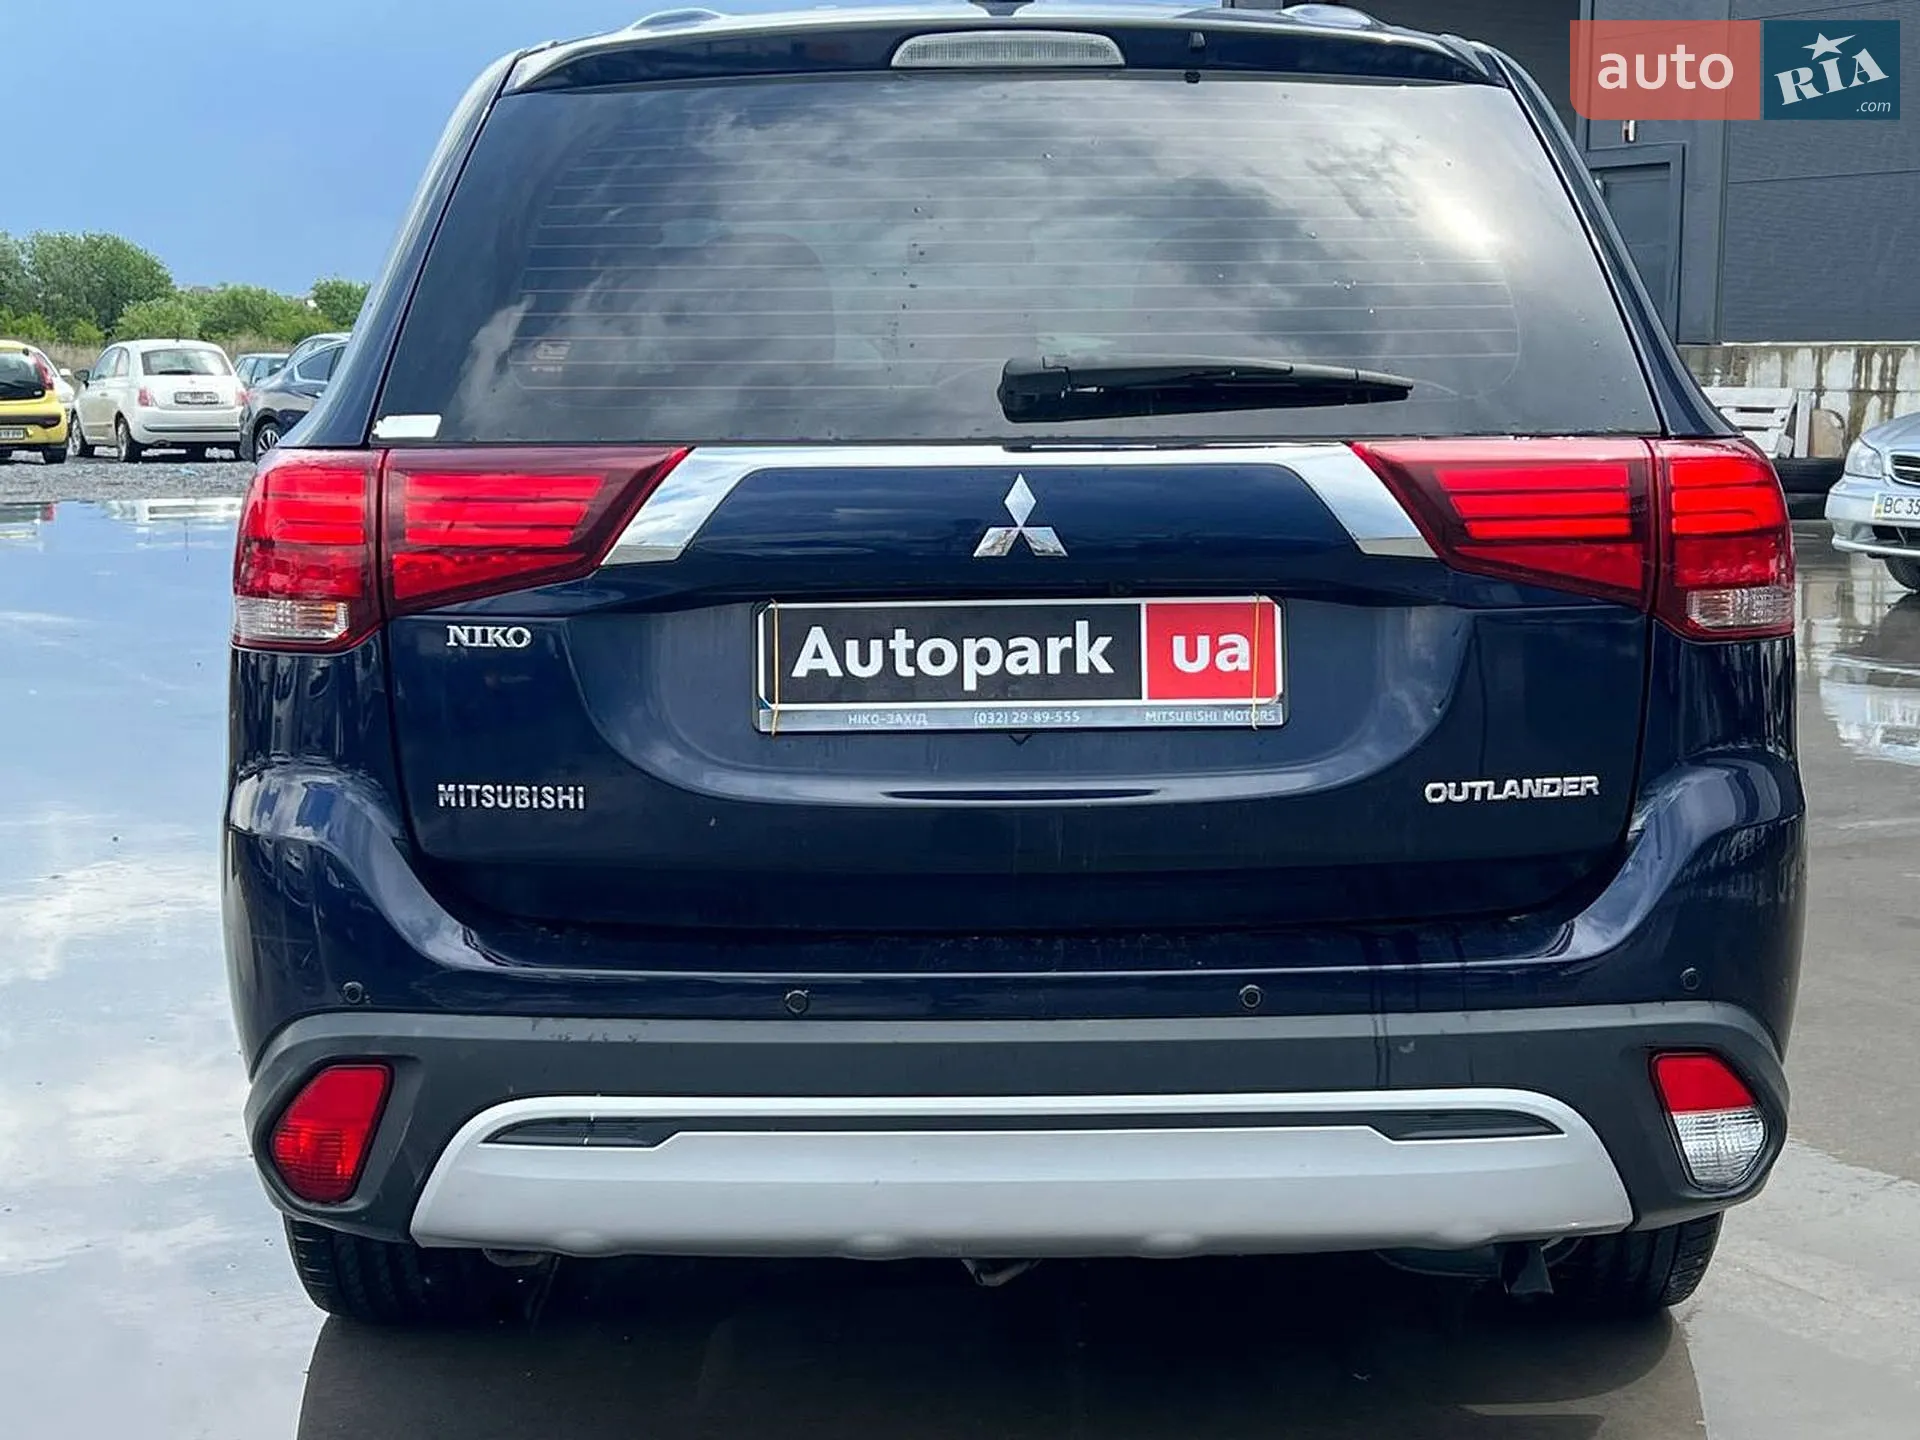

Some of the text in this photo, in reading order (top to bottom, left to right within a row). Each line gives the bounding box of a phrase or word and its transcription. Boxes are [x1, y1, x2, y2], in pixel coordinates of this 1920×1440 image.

[446, 625, 531, 648] NIKO
[791, 620, 1252, 691] Autopark ua
[973, 711, 1008, 725] (032)
[1145, 709, 1276, 722] MITSUBISHI MOTORS
[437, 784, 585, 809] MITSUBISHI
[1424, 776, 1600, 803] OUTLANDER
